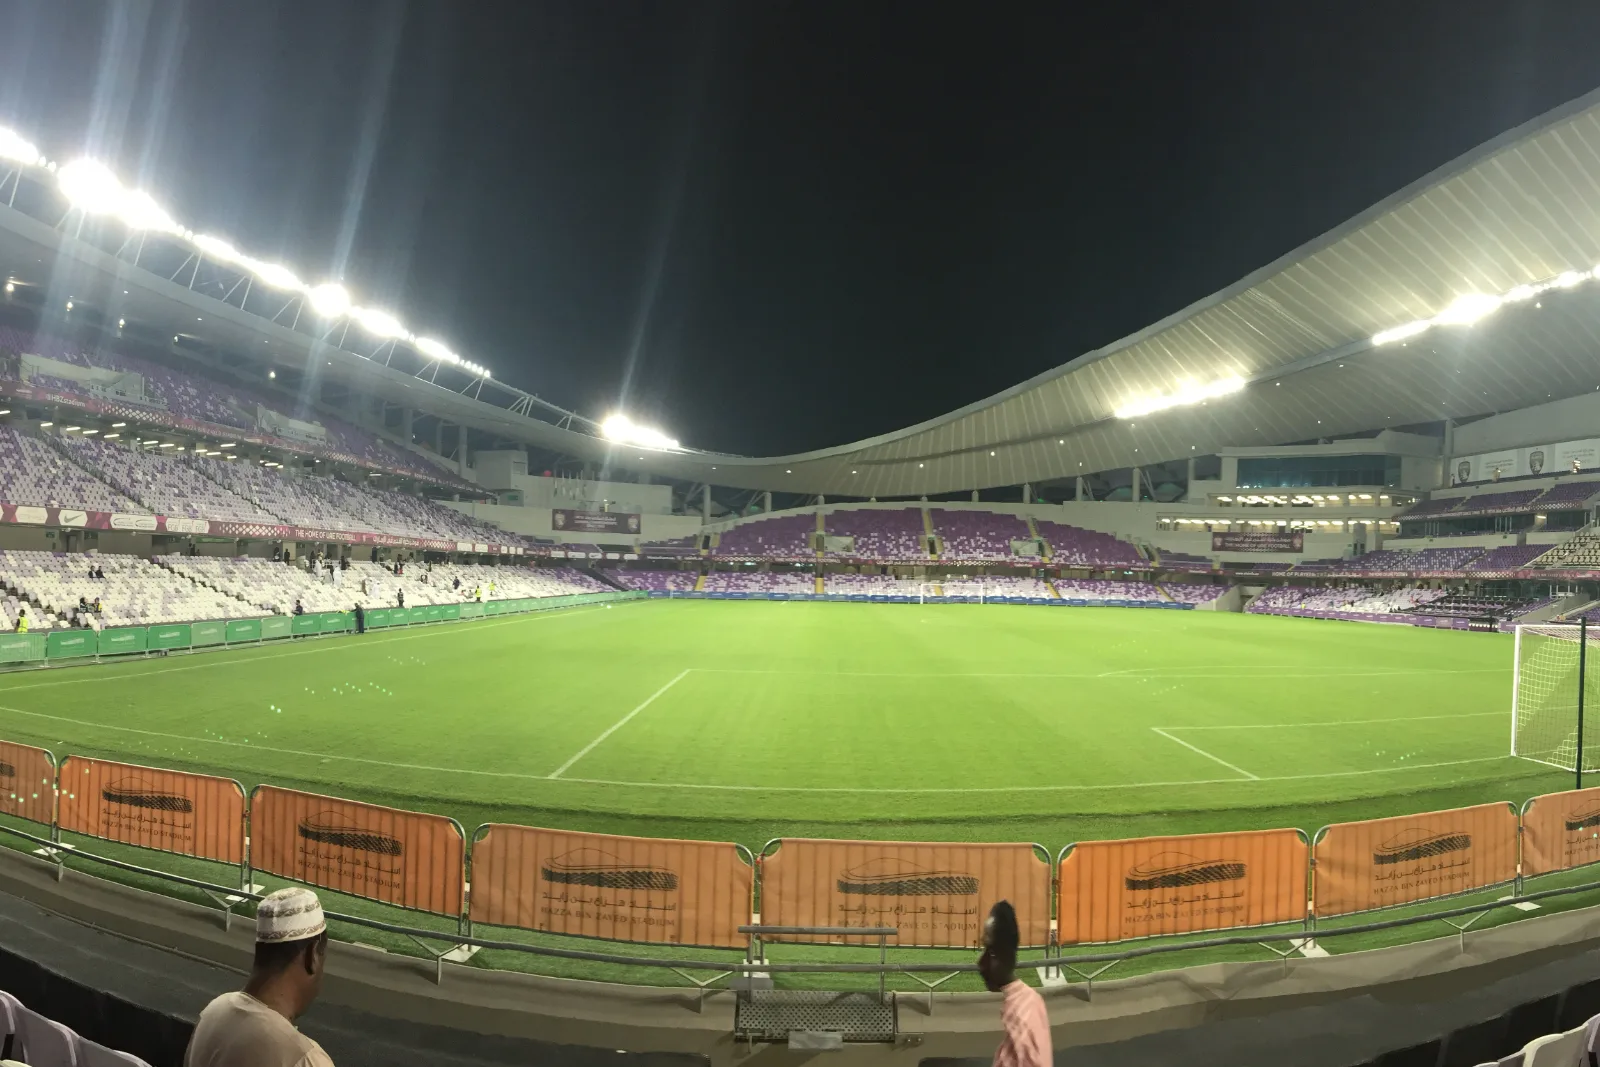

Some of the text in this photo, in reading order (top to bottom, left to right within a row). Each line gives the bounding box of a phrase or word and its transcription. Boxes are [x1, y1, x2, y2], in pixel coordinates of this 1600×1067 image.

[295, 529, 304, 538] THE
[305, 530, 319, 539] HOME
[319, 531, 326, 539] OF
[336, 532, 356, 541] FOOTBALL
[137, 826, 159, 835] ZAYED
[160, 830, 191, 841] STADIUM
[322, 865, 335, 873] BIN
[337, 869, 362, 880] ZAYED
[364, 875, 400, 889] STADIUM
[1415, 877, 1438, 887] ZAYED
[1439, 871, 1470, 884] STADIUM
[576, 911, 592, 919] BIN
[596, 913, 627, 923] ZAYED
[630, 916, 675, 926] STADIUM
[896, 922, 928, 930] ZAYED
[931, 922, 976, 930] STADIUM
[1125, 914, 1155, 923] HAZZA
